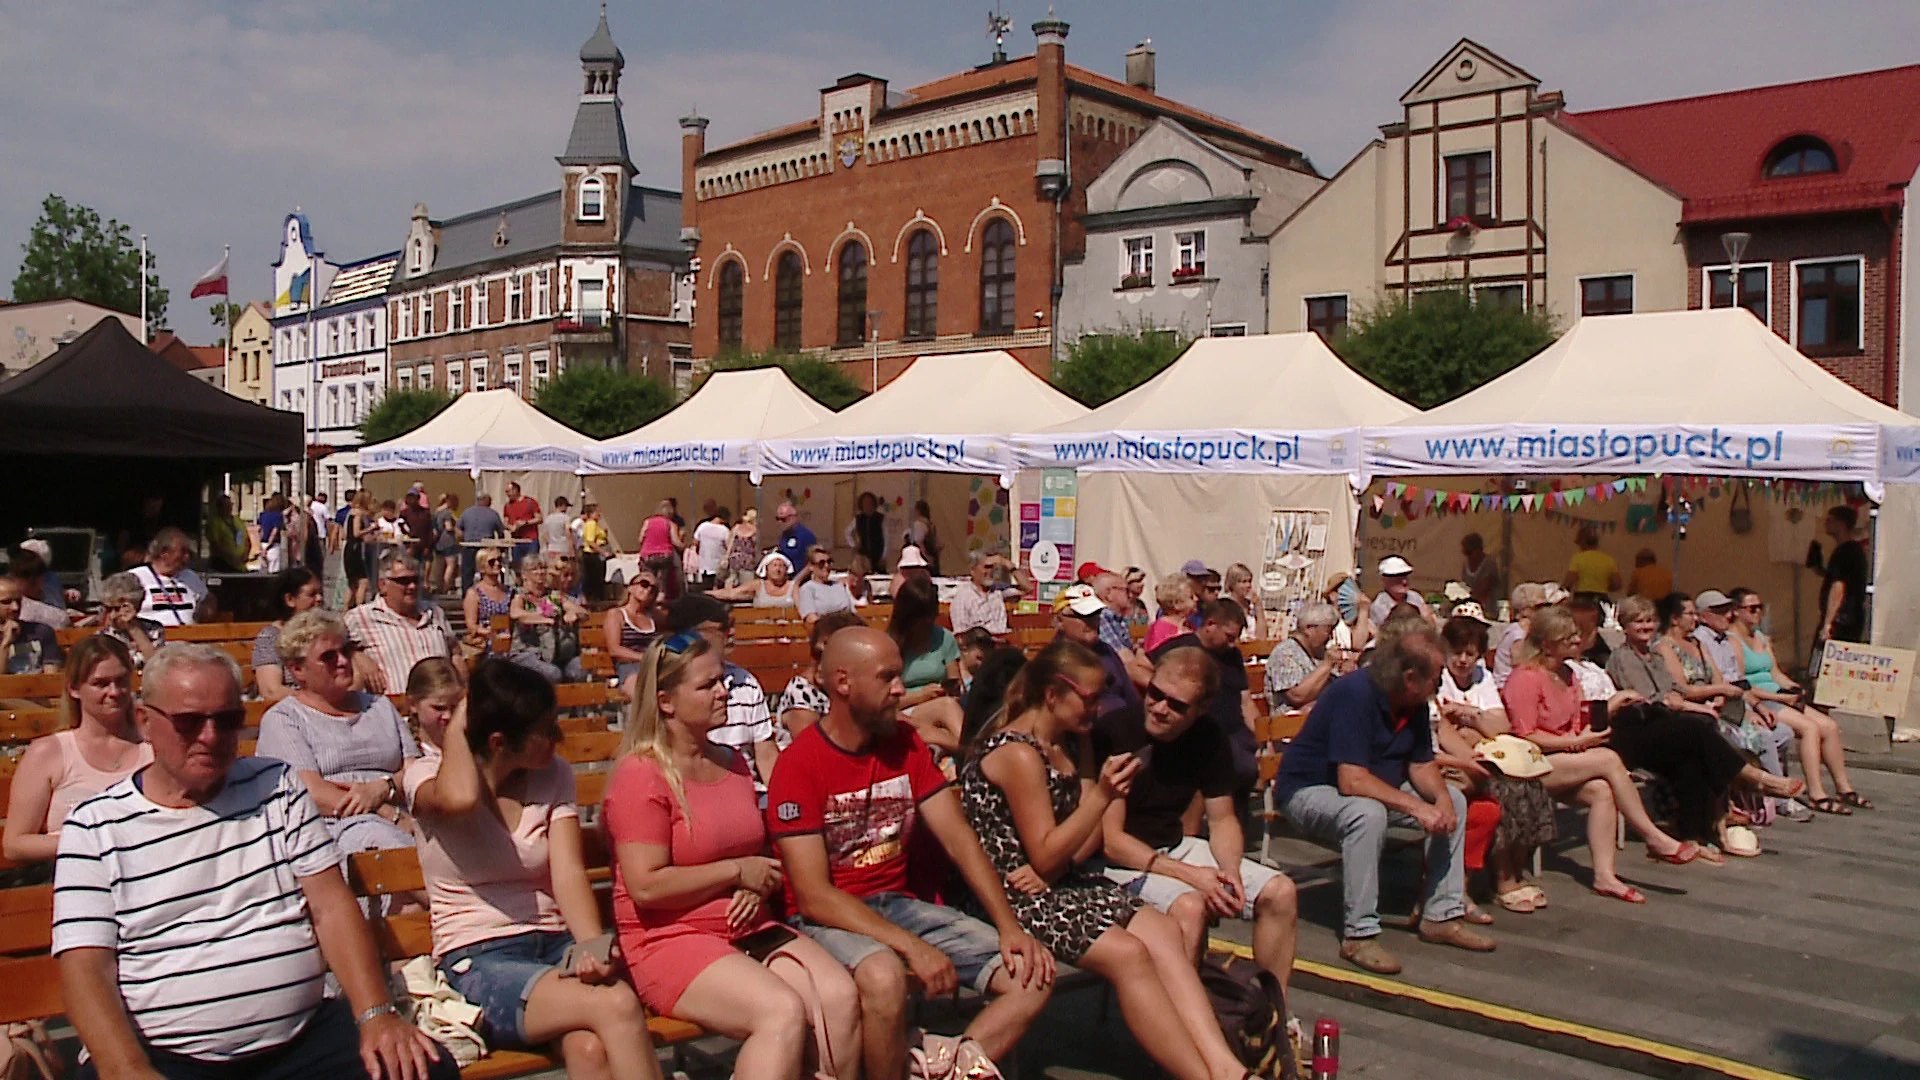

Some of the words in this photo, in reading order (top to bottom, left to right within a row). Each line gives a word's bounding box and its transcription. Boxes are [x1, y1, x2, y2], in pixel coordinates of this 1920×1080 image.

[602, 443, 725, 464] www.miastopuck.pl
[790, 439, 965, 463] www.miastopuck.pl
[1053, 435, 1300, 467] www.miastopuck.pl
[1425, 428, 1783, 469] www.miastopuck.pl
